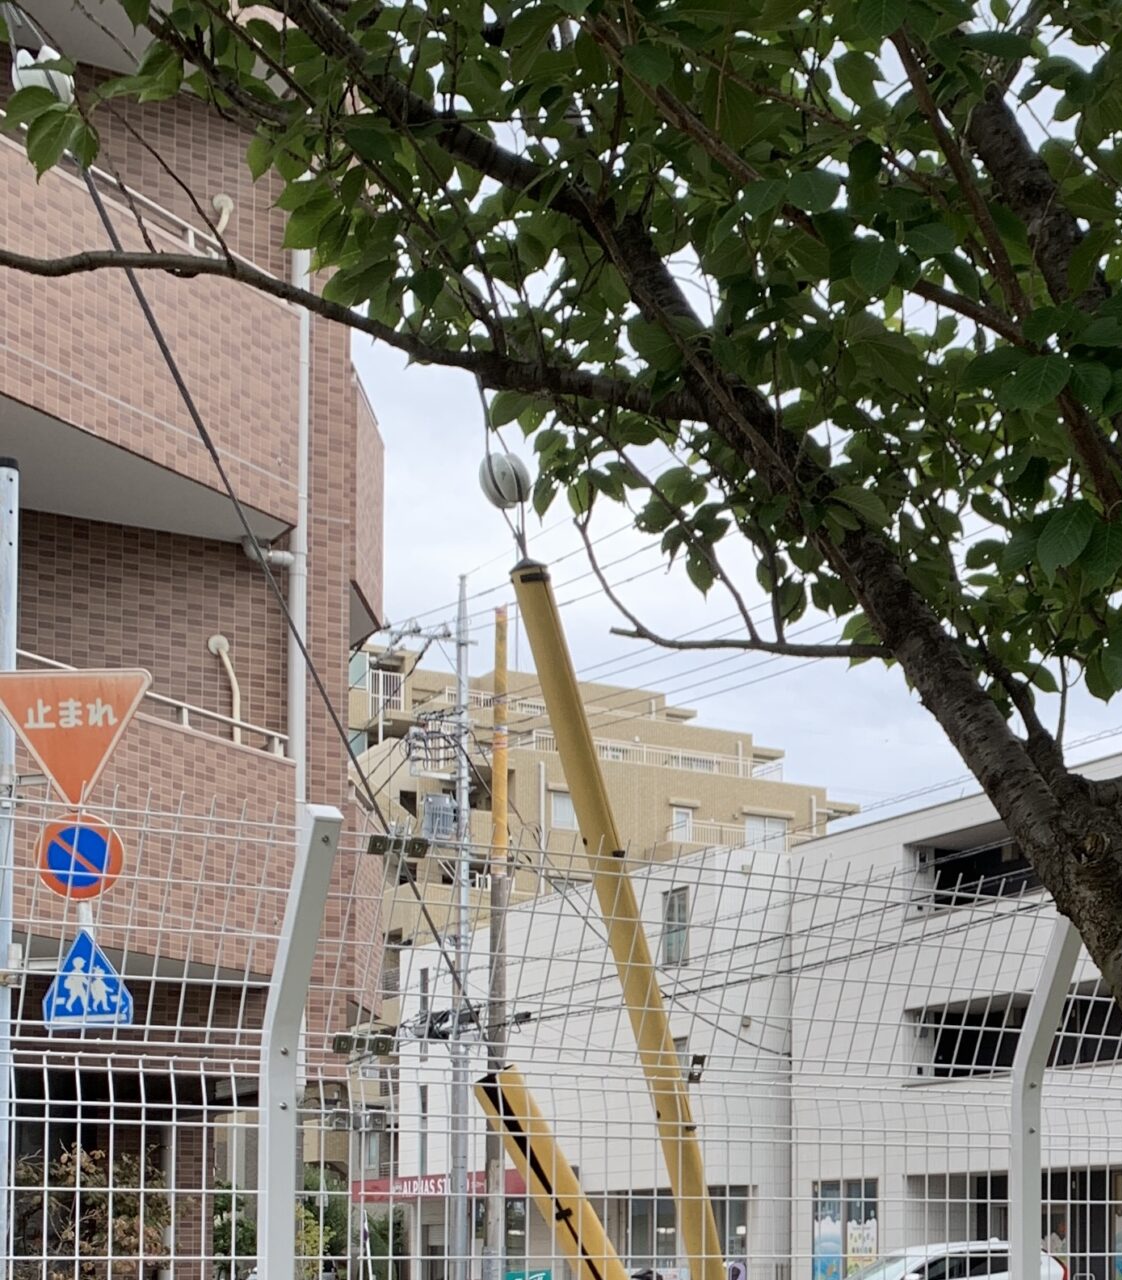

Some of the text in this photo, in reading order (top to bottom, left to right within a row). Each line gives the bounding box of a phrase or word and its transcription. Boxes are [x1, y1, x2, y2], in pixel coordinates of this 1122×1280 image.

[24, 697, 118, 728] 止まれ
[403, 1179, 435, 1195] ALPHAS
